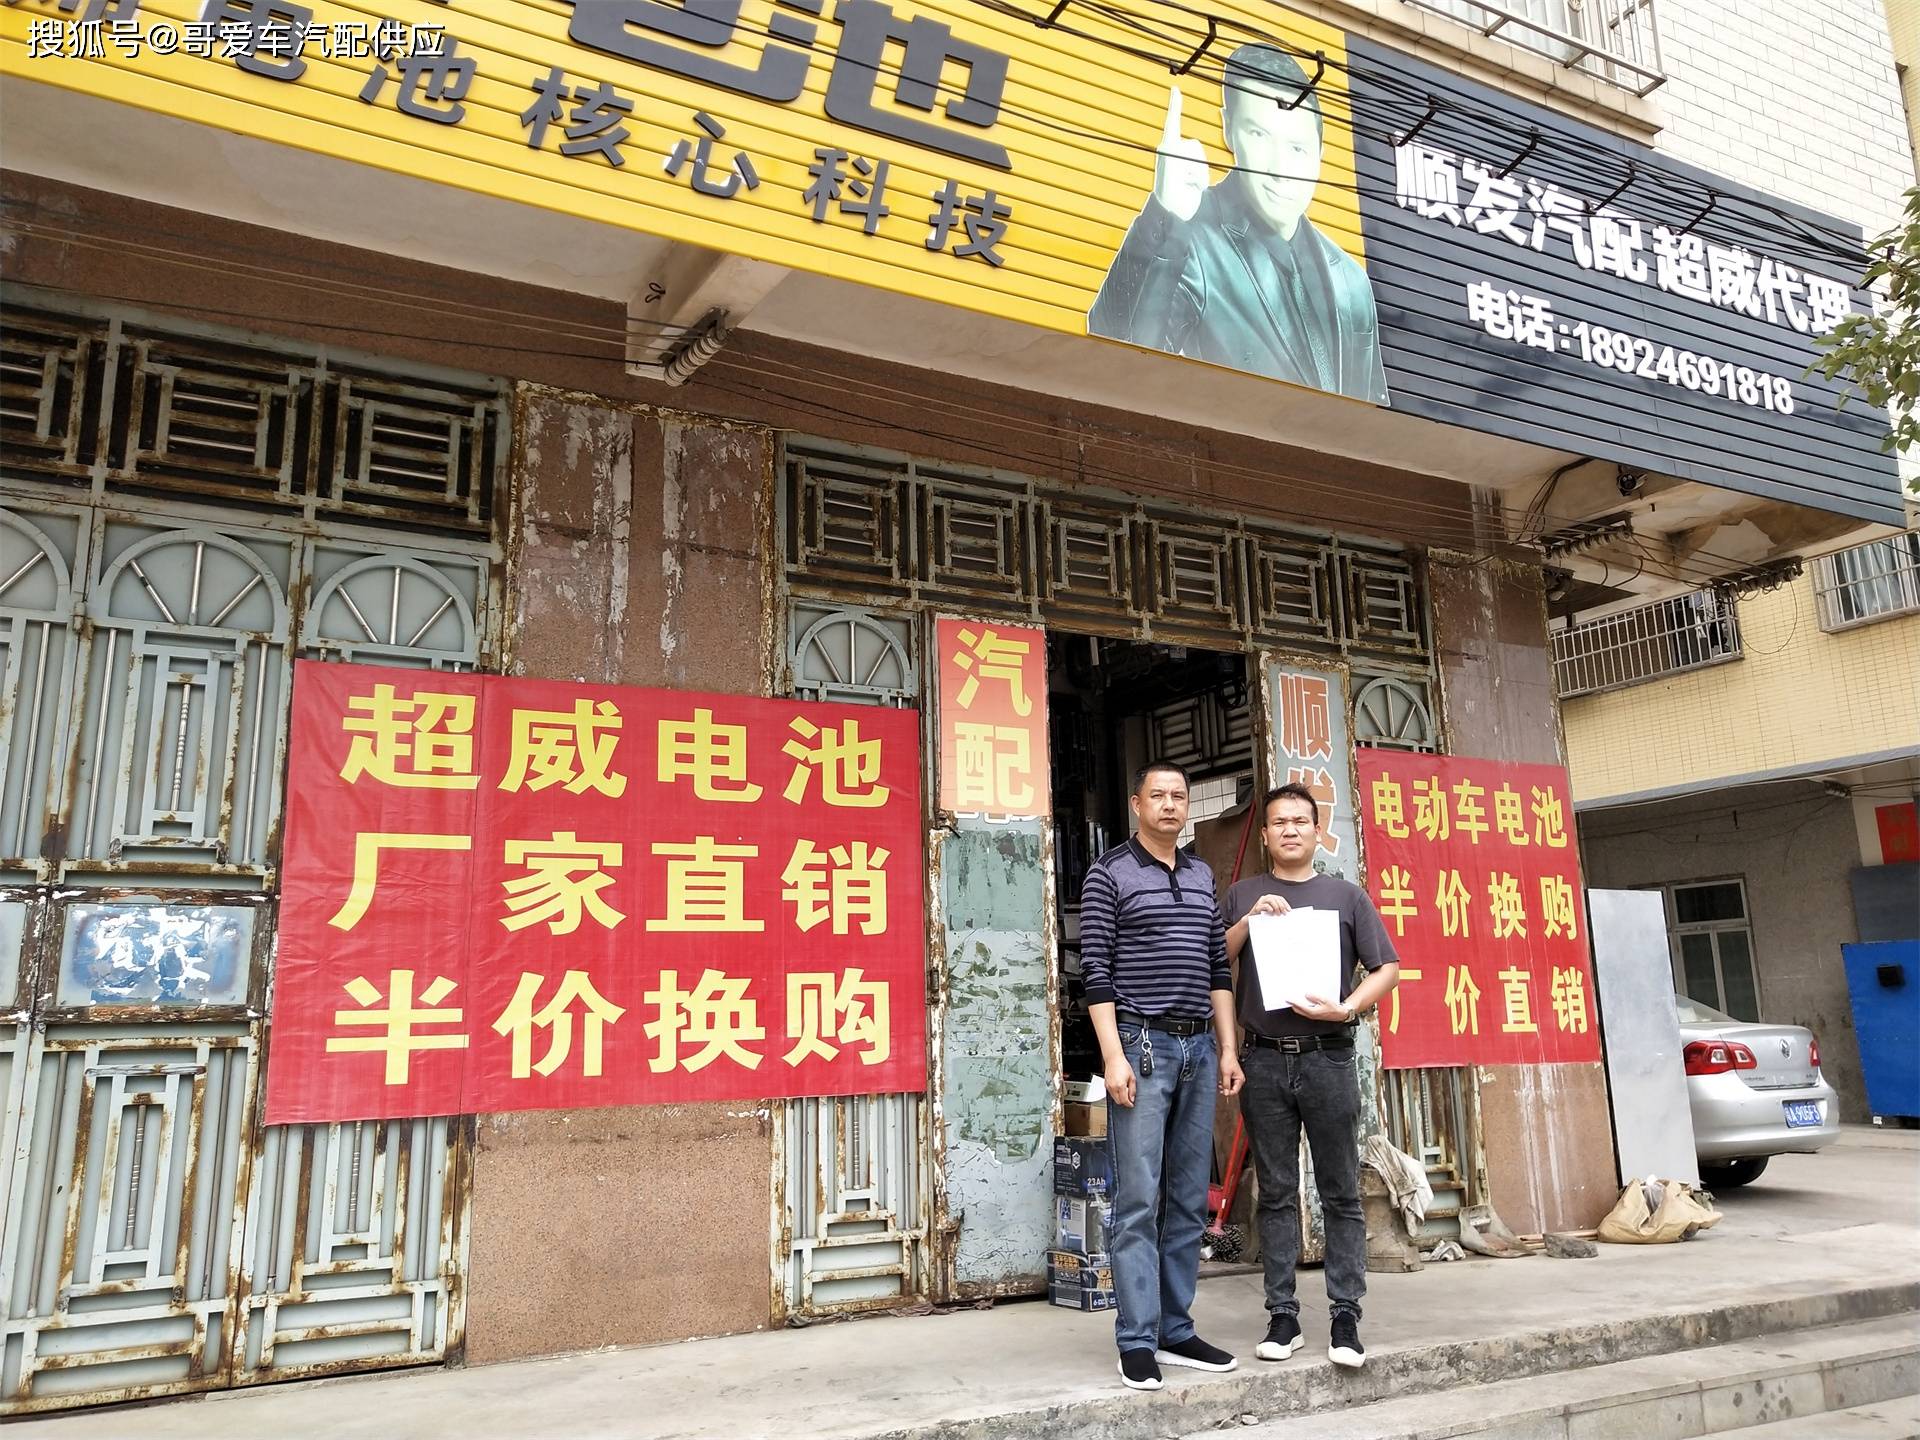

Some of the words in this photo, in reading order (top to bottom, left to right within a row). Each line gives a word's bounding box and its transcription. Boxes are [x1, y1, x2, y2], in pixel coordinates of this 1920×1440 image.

[1394, 131, 1647, 282] 顺发汽配
[1652, 226, 1855, 341] 超威代理
[340, 684, 890, 808] 超威电池
[952, 628, 1034, 808] 汽配
[1372, 772, 1567, 848] 电动车电池
[328, 831, 891, 935] 厂家直销
[1380, 865, 1578, 940] 半价换购
[325, 969, 891, 1086] 半价换购
[1388, 965, 1588, 1035] 厂价直销
